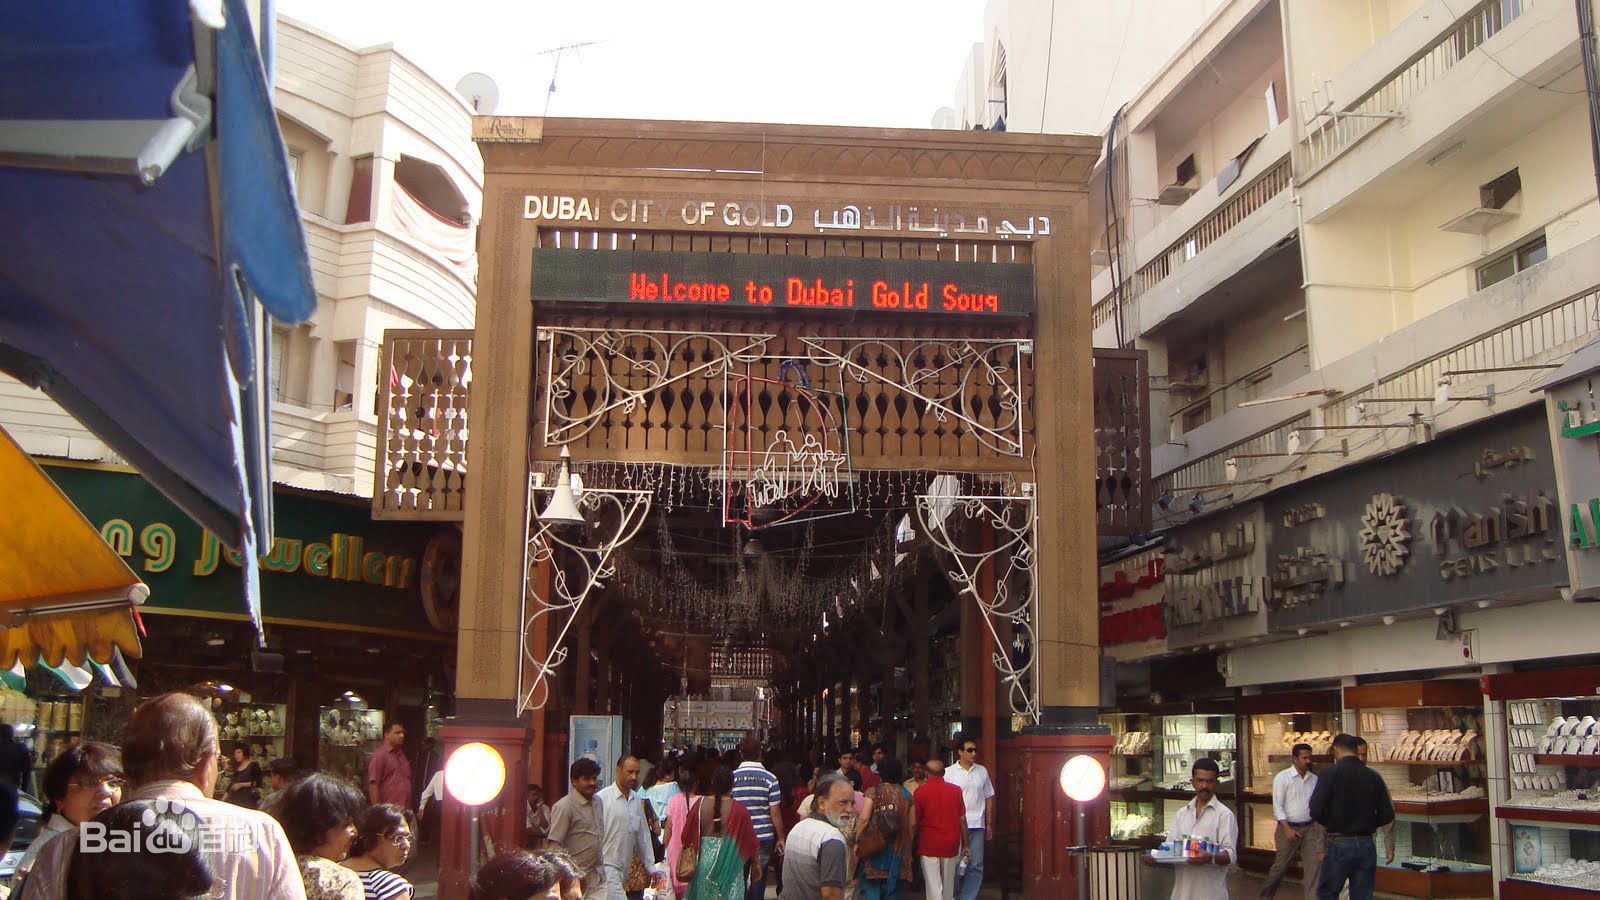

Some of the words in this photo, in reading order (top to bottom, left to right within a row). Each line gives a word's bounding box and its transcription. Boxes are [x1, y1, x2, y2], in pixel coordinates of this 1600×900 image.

[524, 195, 599, 221] DUBAI
[682, 200, 715, 225] OF
[722, 202, 794, 228] GOLD
[995, 216, 1050, 239] دبي
[629, 272, 731, 302] Welcome
[745, 281, 773, 305] to
[787, 277, 854, 306] Dubai
[871, 279, 930, 311] Gold
[942, 283, 999, 313] Souq
